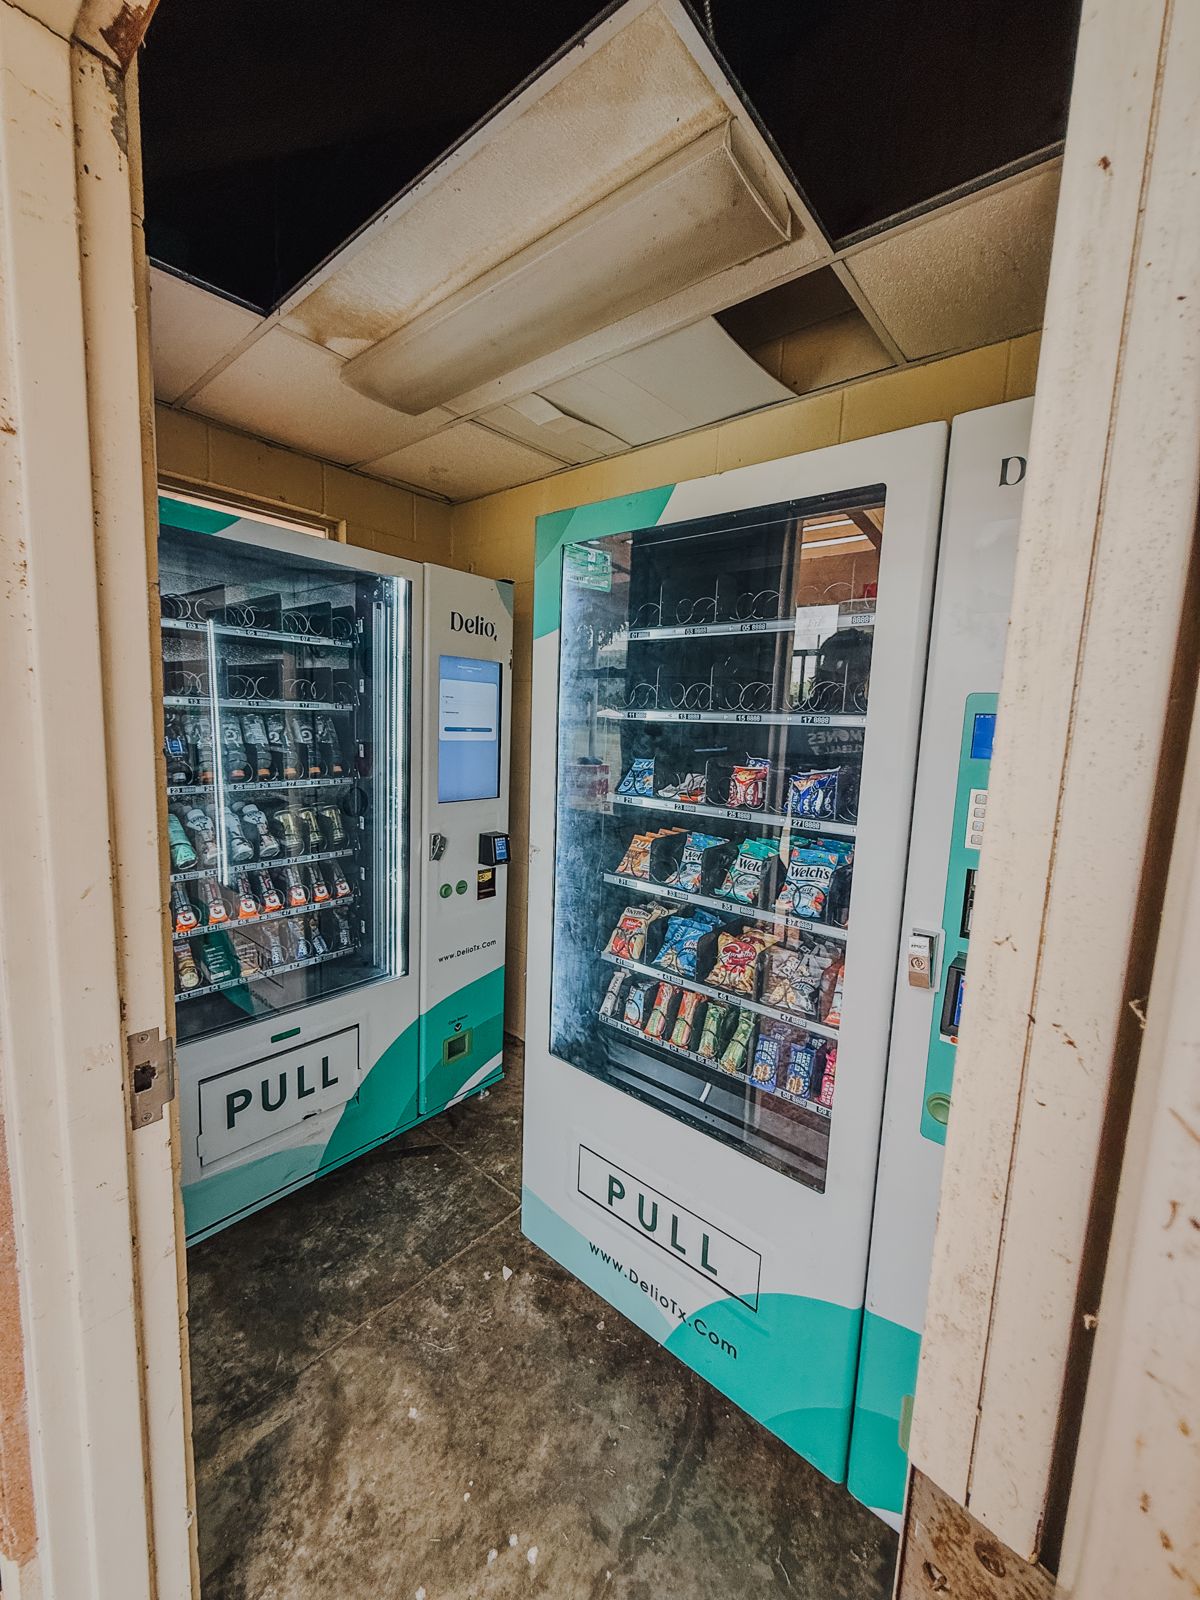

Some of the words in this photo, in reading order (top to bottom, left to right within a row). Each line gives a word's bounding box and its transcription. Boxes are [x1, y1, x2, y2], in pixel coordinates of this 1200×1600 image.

[790, 866, 830, 880] Welch's
[438, 939, 497, 962] www.DelioTx.Com
[225, 1055, 339, 1130] PULL
[607, 1174, 718, 1276] PULL
[588, 1241, 737, 1360] www.DelioTx.Com
